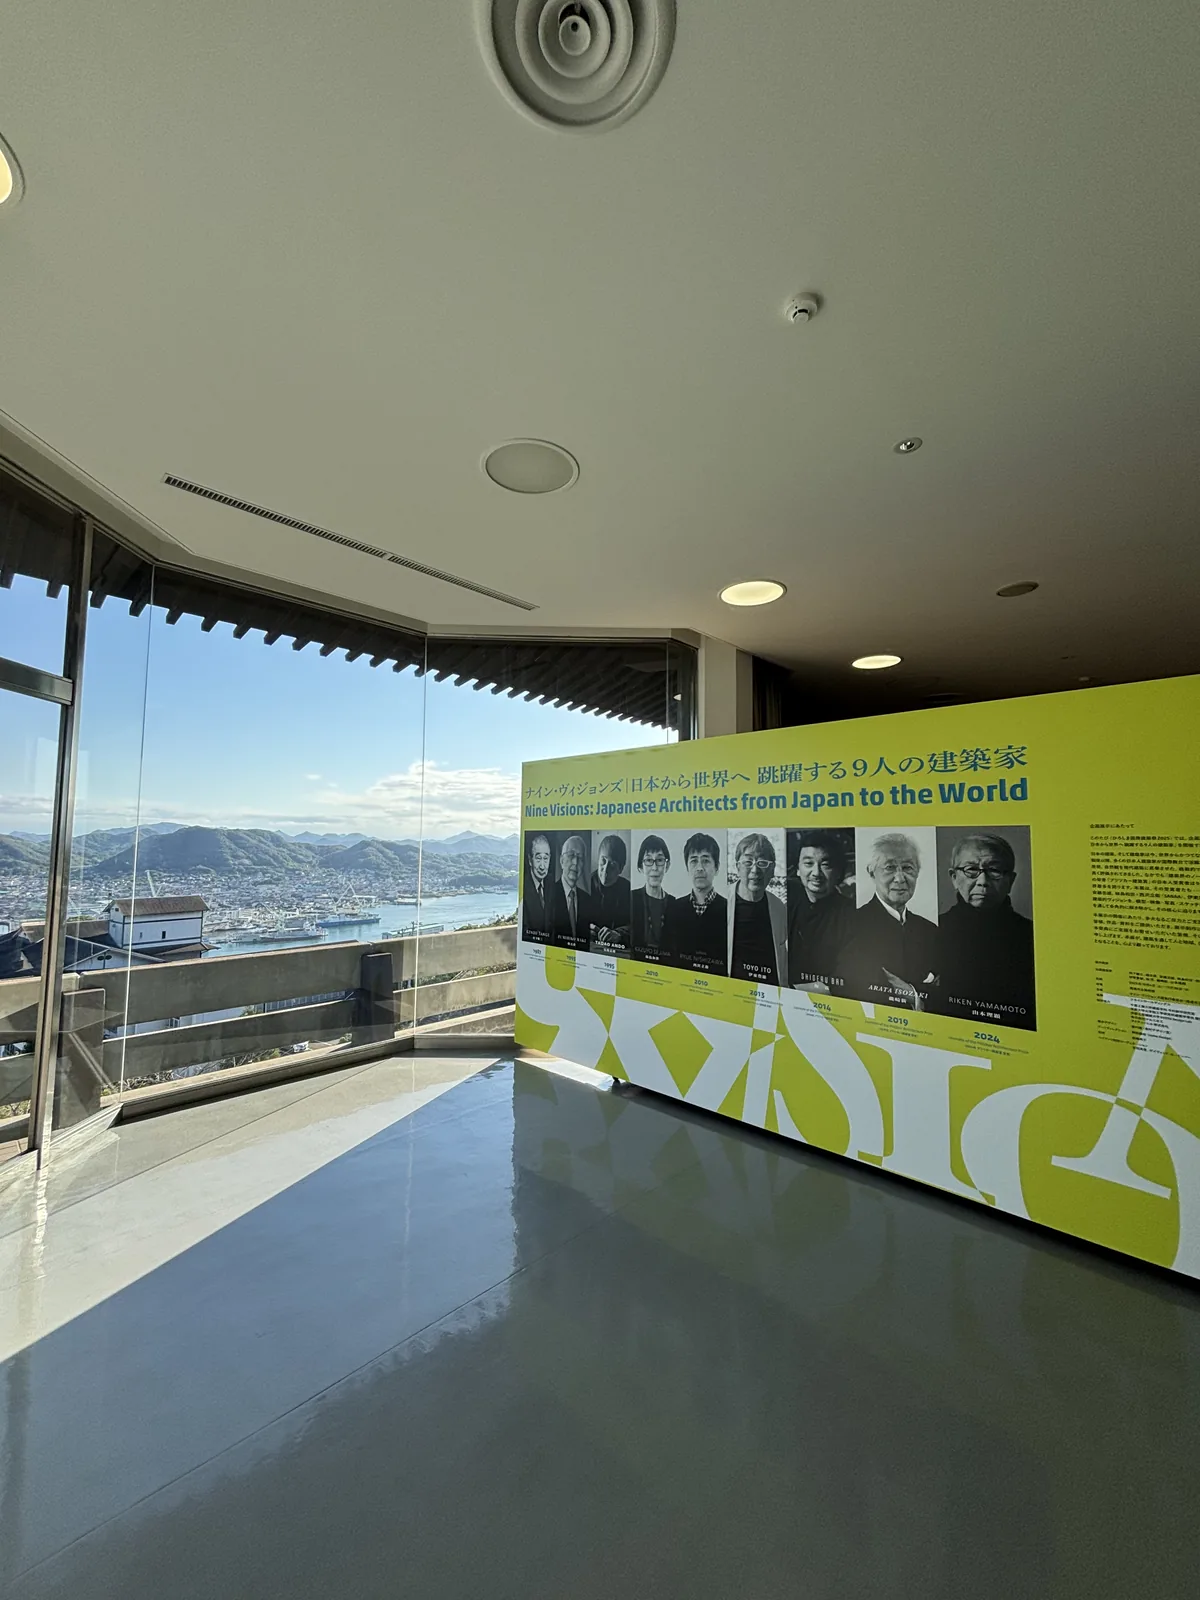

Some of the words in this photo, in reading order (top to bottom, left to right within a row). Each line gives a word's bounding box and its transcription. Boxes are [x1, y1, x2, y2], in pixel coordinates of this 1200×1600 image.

[757, 744, 1028, 785] 跳躍する9人の建築家
[525, 803, 549, 818] Nine
[550, 801, 594, 817] Visions:
[596, 799, 656, 818] Japanese
[659, 794, 738, 813] Architects
[741, 792, 787, 810] from
[792, 789, 855, 812] Japan
[860, 787, 883, 806] to
[890, 783, 933, 804] the
[938, 777, 1029, 804] World
[743, 963, 759, 972] TOYO
[760, 965, 772, 974] ITO
[749, 989, 765, 999] 2013
[868, 984, 893, 994] ARATA
[894, 987, 929, 1000] ISOZAKI
[813, 1002, 832, 1012] 2014
[948, 995, 972, 1007] RIKEN
[975, 1000, 1027, 1016] YAMAMOTO
[887, 1015, 909, 1027] 2019
[974, 1031, 1001, 1044] 2024
